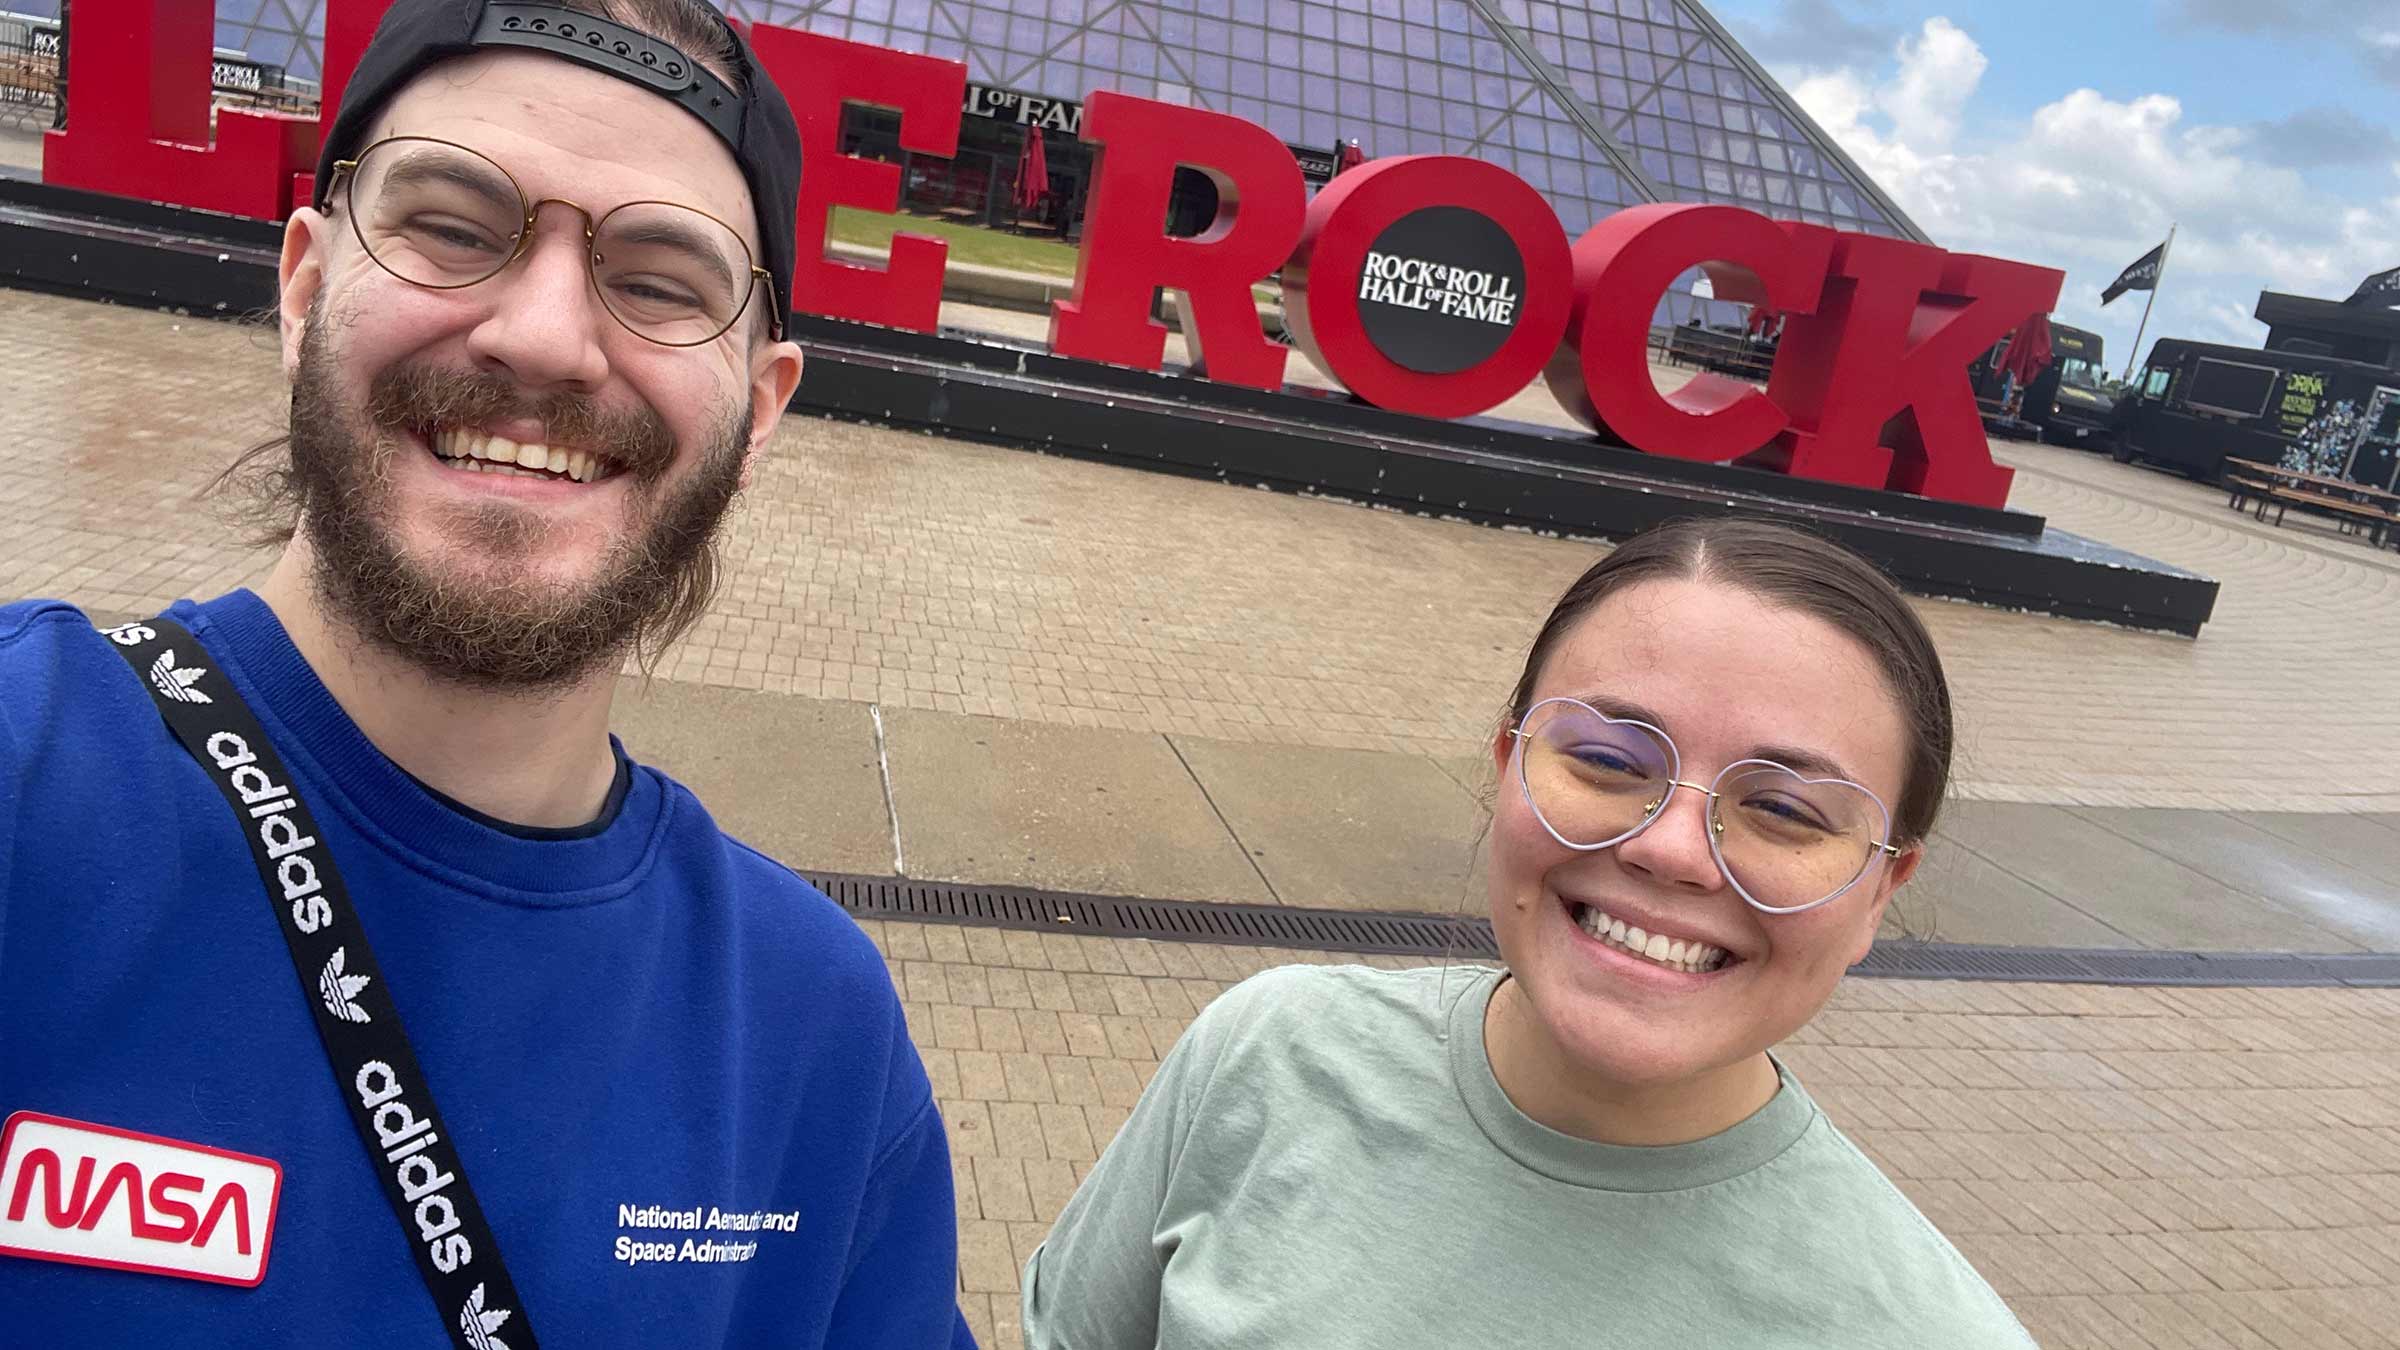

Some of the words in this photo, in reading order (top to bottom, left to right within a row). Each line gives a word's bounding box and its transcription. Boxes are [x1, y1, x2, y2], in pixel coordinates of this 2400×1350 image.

[987, 90, 1019, 108] OF
[1016, 96, 1084, 135] FA
[1050, 90, 2063, 510] ROCK
[1359, 276, 1431, 311] HALL
[1424, 287, 1445, 302] OF
[1440, 291, 1515, 326] FAME
[1364, 252, 1436, 287] ROCK
[1446, 267, 1517, 301] ROLL
[206, 730, 334, 934] adidas
[355, 1059, 472, 1275] adidas
[7, 1147, 252, 1256] NASA
[618, 1204, 702, 1230] National
[762, 1211, 800, 1232] and
[614, 1236, 676, 1266] Space
